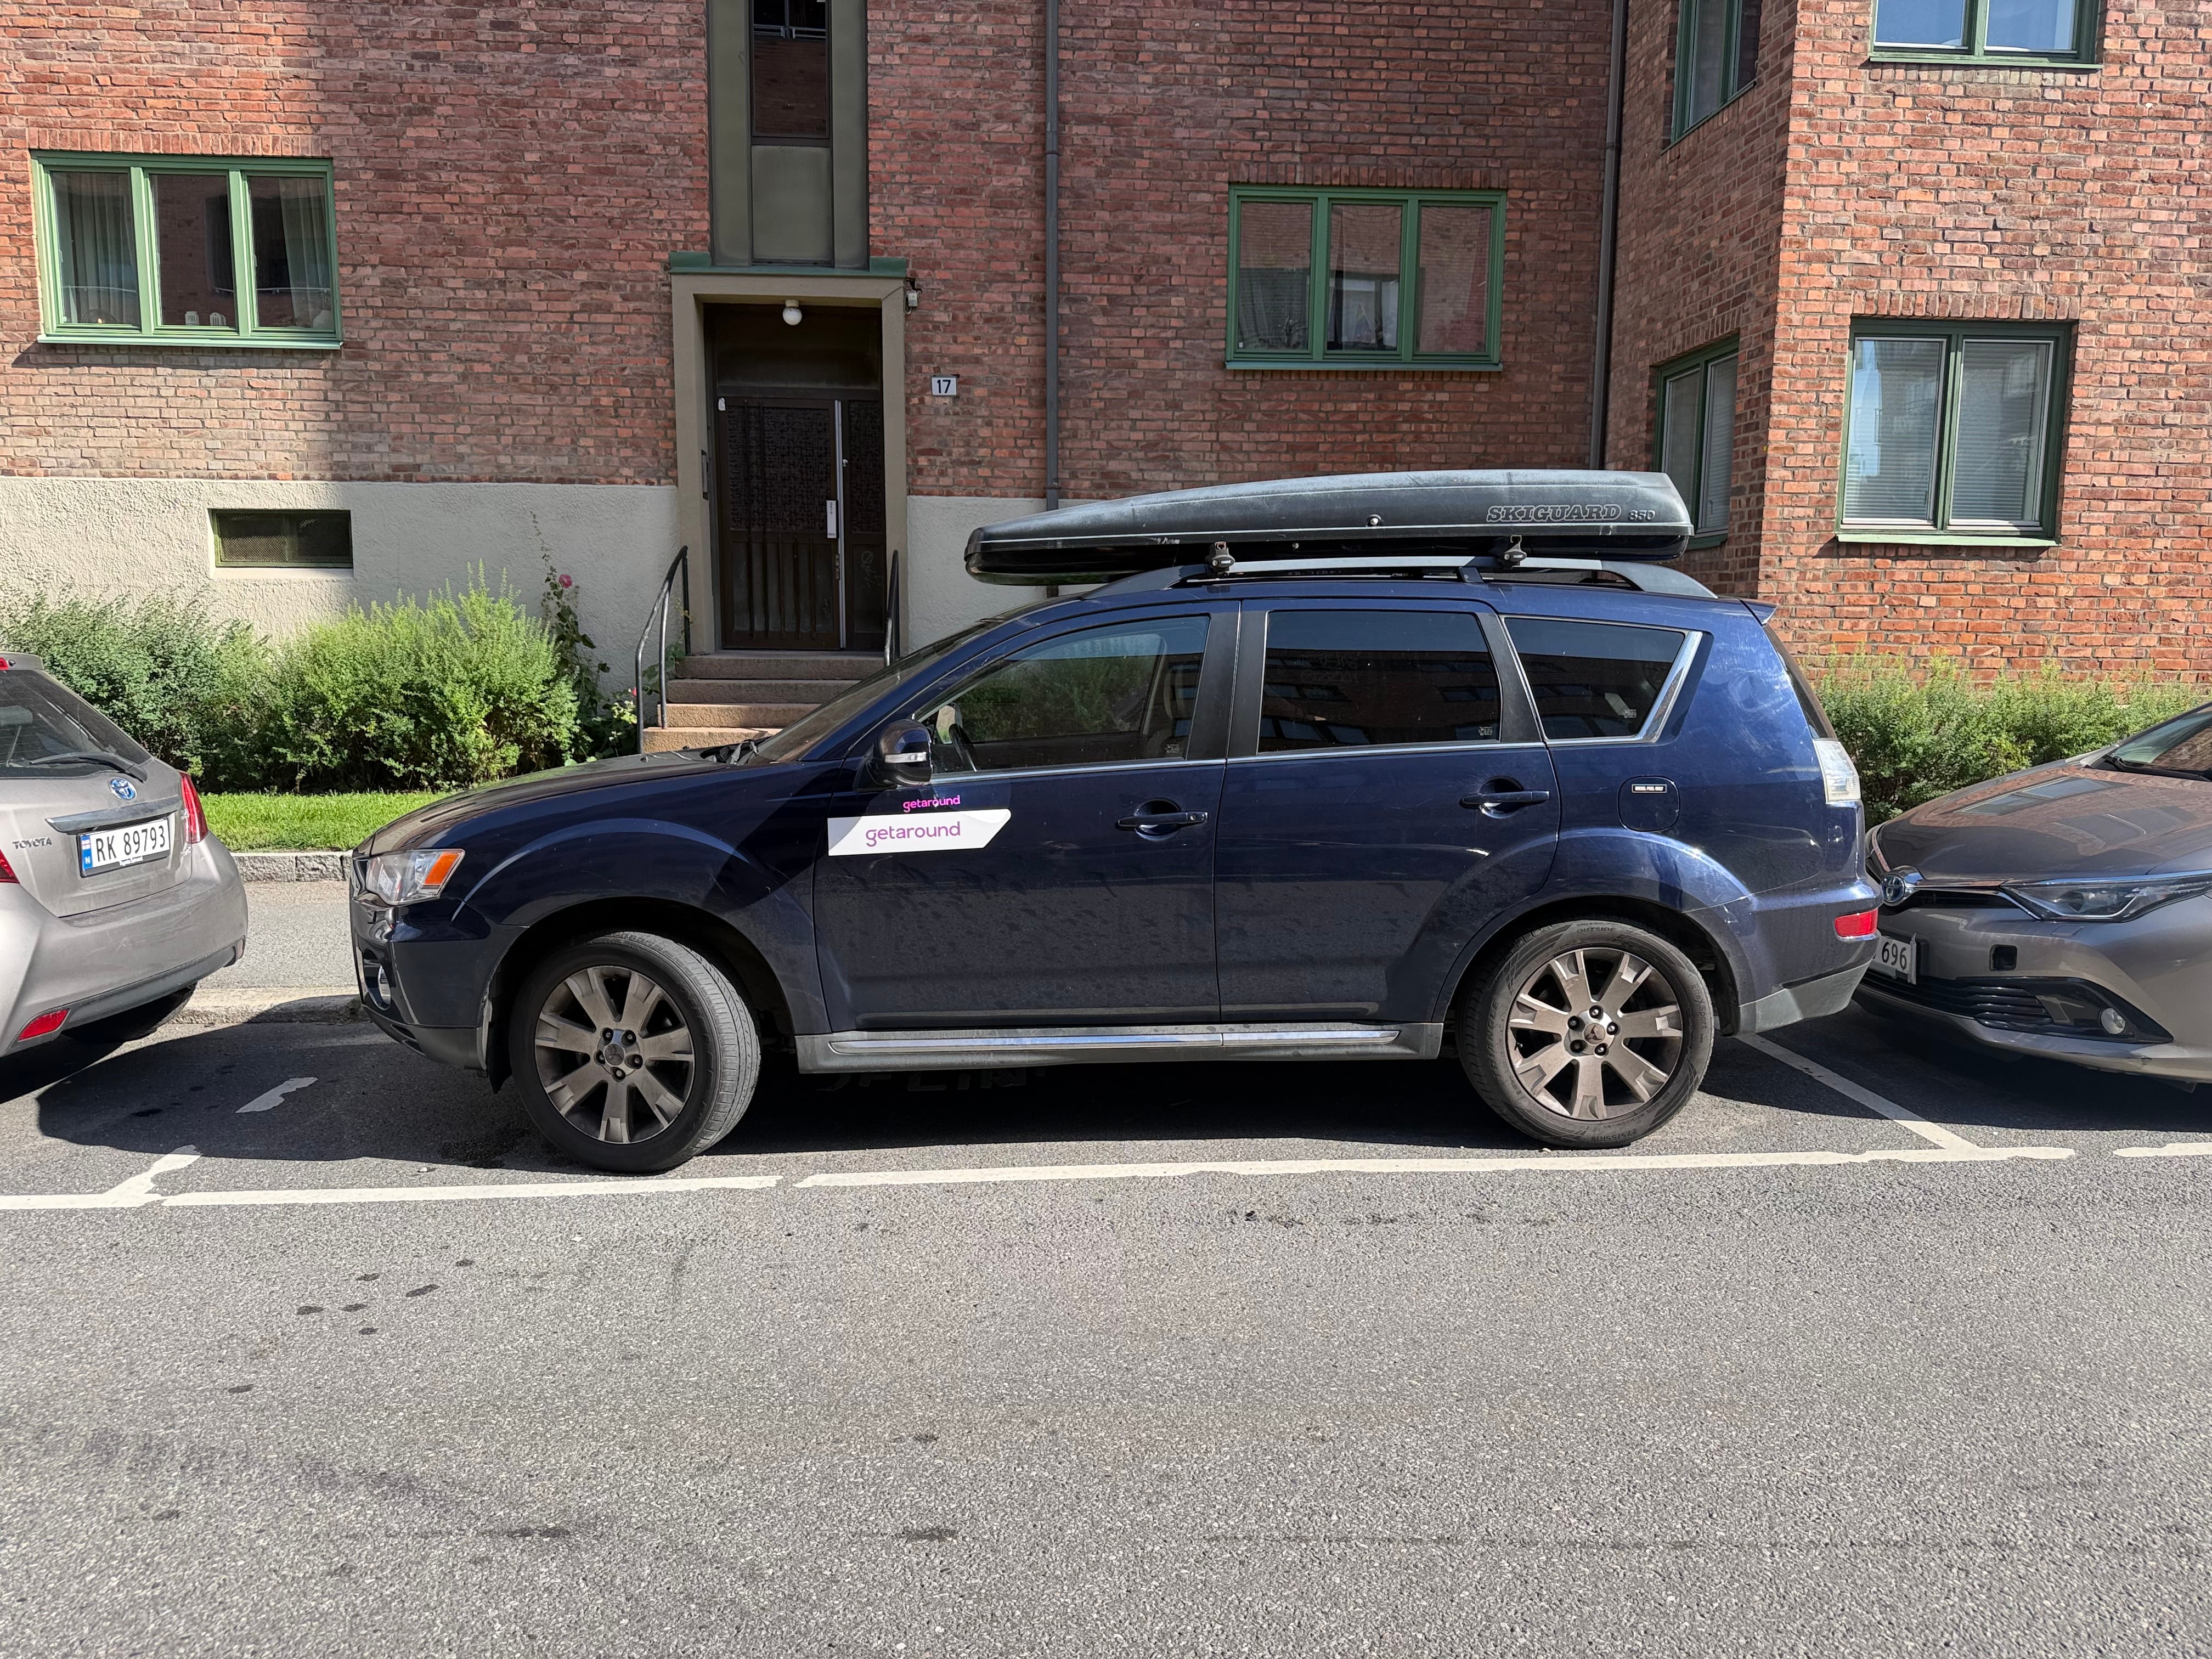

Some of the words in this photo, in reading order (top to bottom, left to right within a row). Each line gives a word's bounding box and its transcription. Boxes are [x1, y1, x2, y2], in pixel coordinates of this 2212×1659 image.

[937, 380, 951, 393] 17
[1487, 504, 1622, 522] SKIGUARD
[902, 795, 961, 813] getaround
[12, 837, 53, 850] TOYOTA
[95, 835, 117, 862] RK
[123, 825, 165, 856] 89793
[866, 821, 961, 847] getaround
[1872, 941, 1907, 970] 696
[1486, 998, 1502, 1081] TRIANGLE
